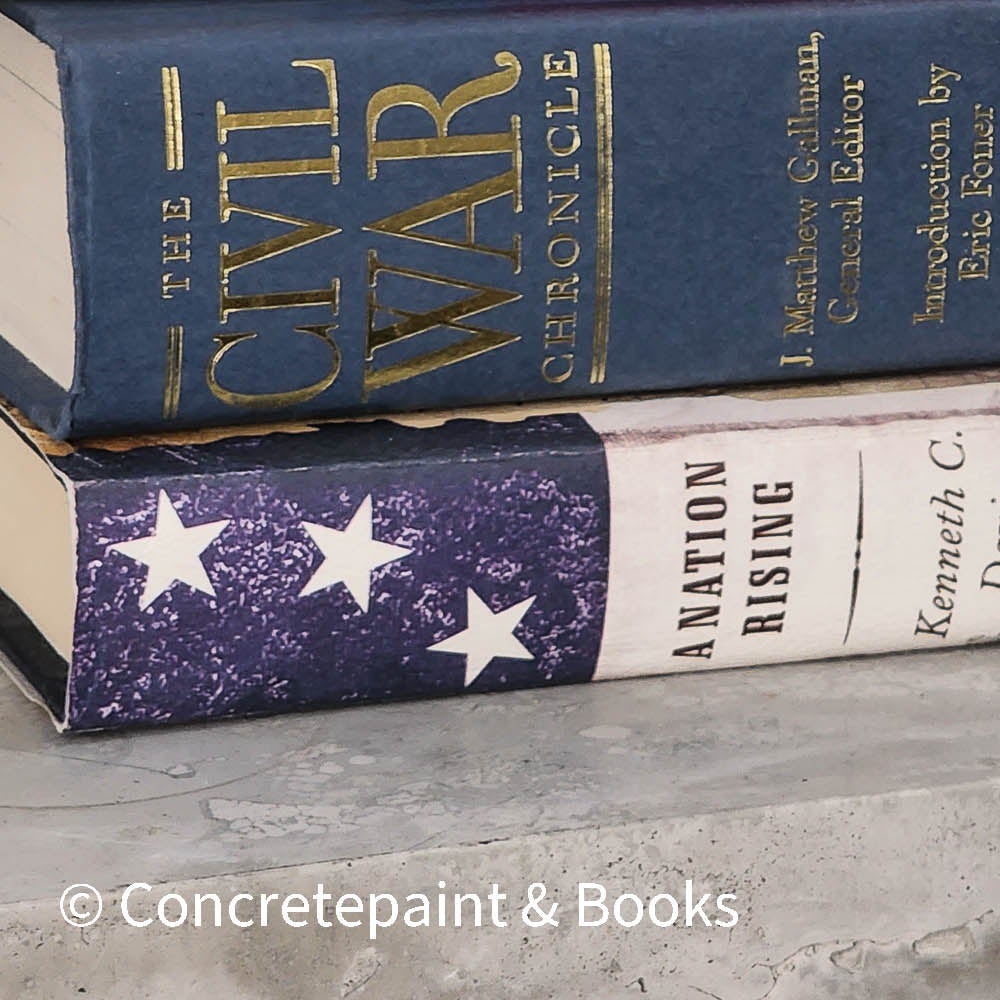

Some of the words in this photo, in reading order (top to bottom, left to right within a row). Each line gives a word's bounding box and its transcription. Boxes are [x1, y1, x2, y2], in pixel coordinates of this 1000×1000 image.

[787, 30, 824, 183] Gallman,
[831, 74, 865, 185] Editor
[918, 62, 962, 106] by
[960, 103, 995, 199] Foner
[162, 196, 191, 298] THE
[207, 57, 343, 407] CIVIL
[362, 51, 523, 399] WAR
[540, 49, 581, 384] CHRONICLE
[783, 199, 819, 338] Matthew
[827, 195, 864, 324] General
[912, 116, 951, 325] Introduction
[958, 210, 992, 280] Eric
[780, 347, 814, 367] J.
[928, 431, 966, 471] C.
[677, 460, 727, 631] NATION
[741, 481, 794, 636] RISING
[914, 487, 966, 639] Kenneth
